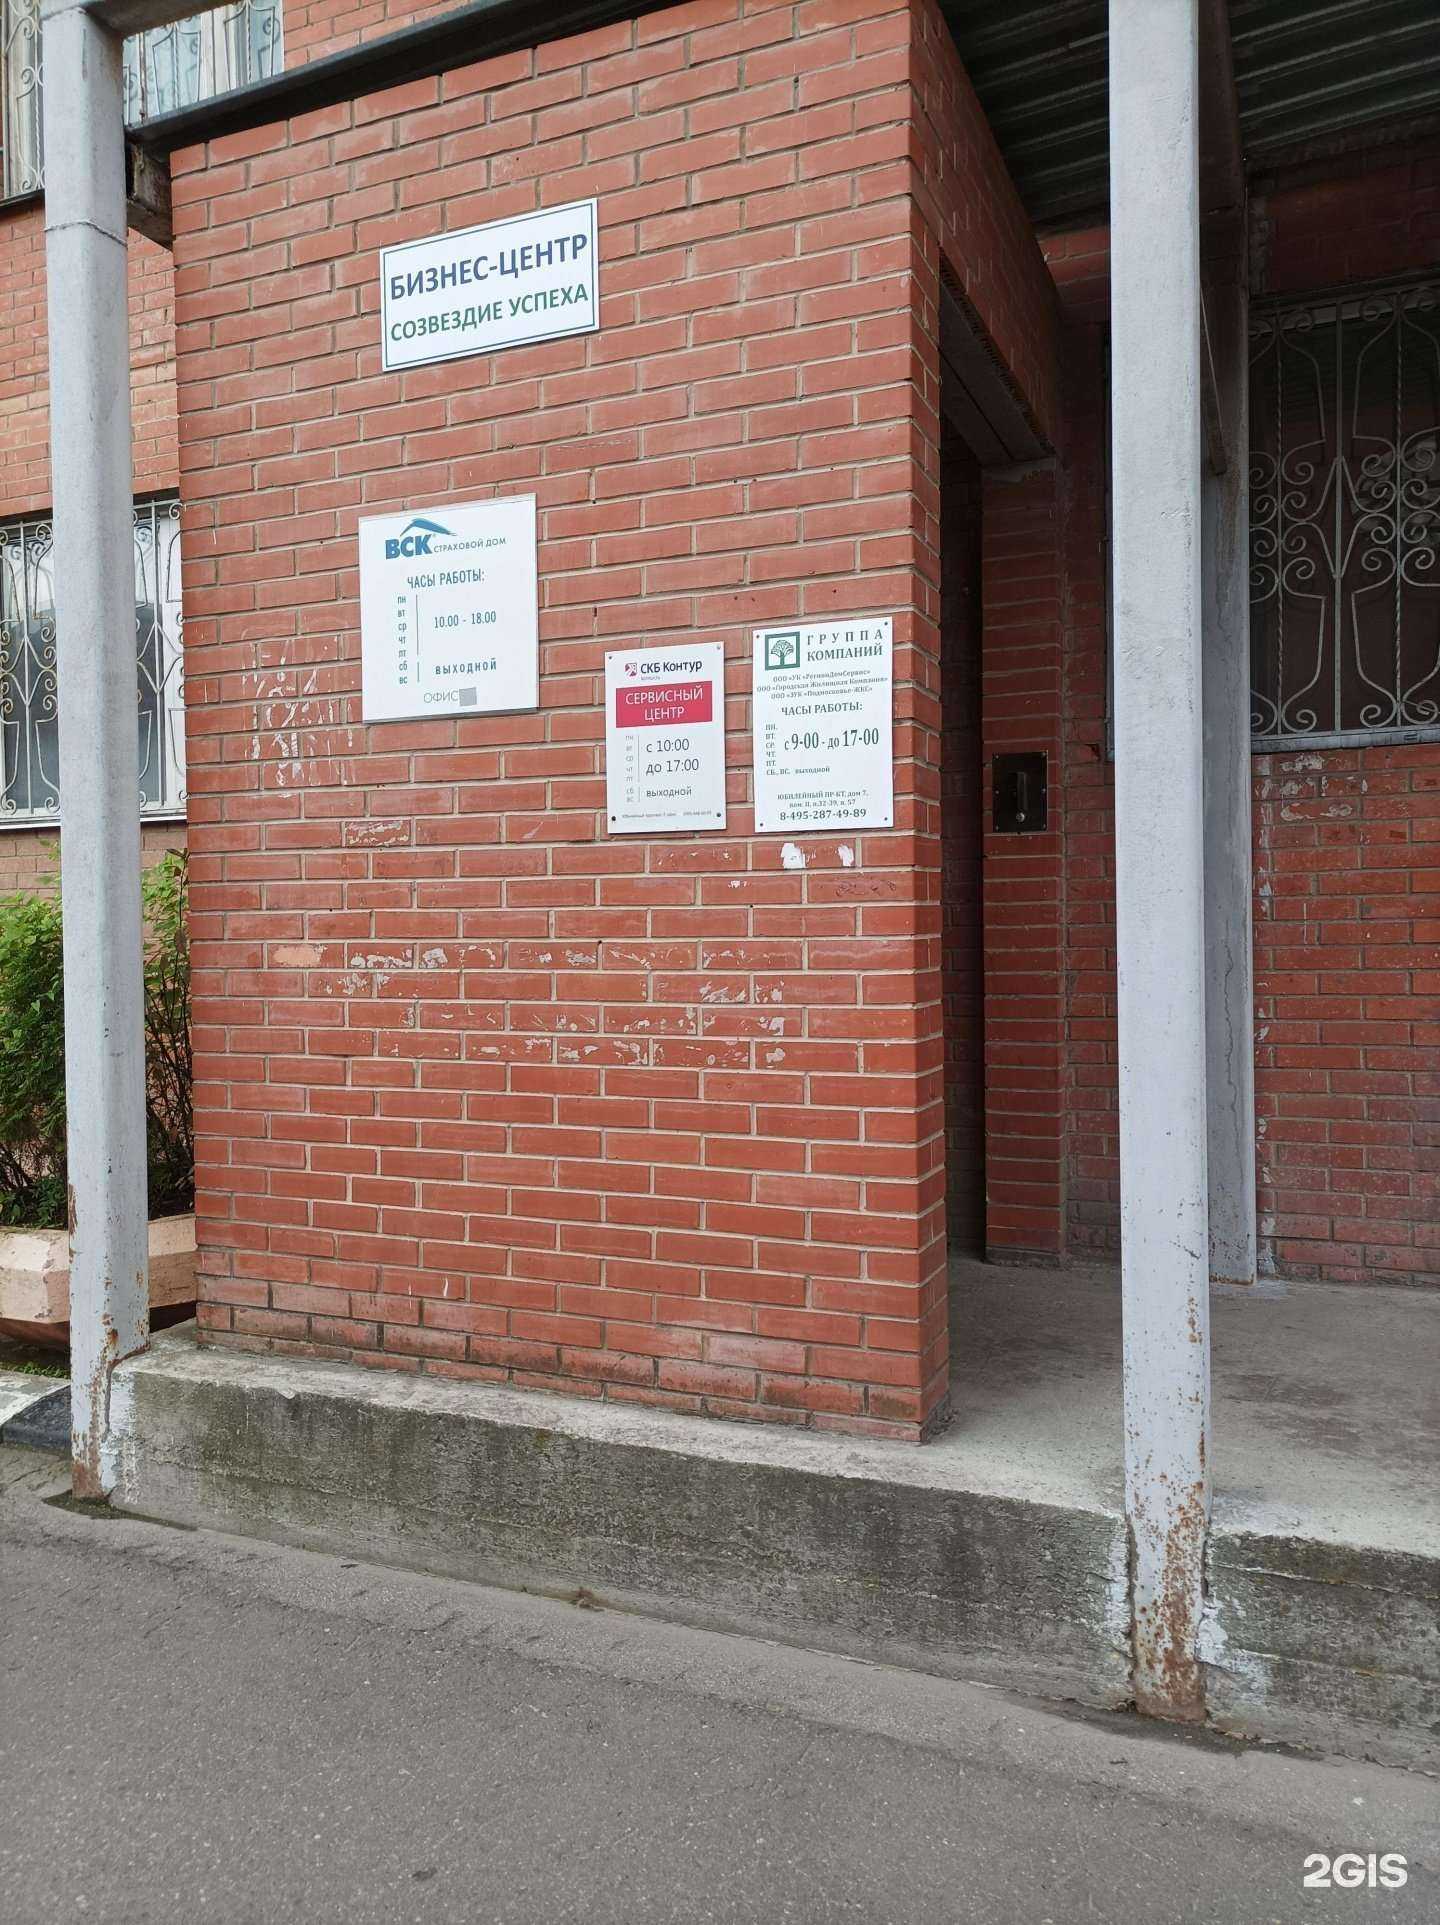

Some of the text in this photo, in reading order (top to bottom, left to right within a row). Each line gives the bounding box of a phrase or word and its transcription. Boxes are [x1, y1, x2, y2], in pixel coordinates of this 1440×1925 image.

[390, 234, 588, 300] БИЗНЕС-ЦЕНТР
[391, 283, 588, 341] СОЗВЕЗДИЕ УСПЕХА
[385, 534, 507, 560] ВСК СТРАХОВОЙ ДОМ
[407, 569, 485, 589] ЧАСЫ РАБОТЫ:
[398, 623, 407, 632] ср
[434, 614, 459, 628] 10.00
[471, 611, 497, 625] 18.00
[807, 629, 883, 645] ГРУППА
[807, 642, 883, 661] КОМПАНИЙ
[399, 660, 408, 671] сб
[435, 657, 497, 675] выходной
[640, 661, 703, 674] СКБ Контур
[424, 690, 459, 703] ОФИС
[625, 685, 703, 705] СЕРВИСНЫЙ
[644, 706, 685, 722] ЦЕНТР
[781, 701, 863, 715] ЧАСЫ РАБОТЫ:
[646, 738, 690, 752] с 10:00
[791, 732, 819, 750] 9-00
[828, 738, 840, 749] до
[842, 728, 879, 747] 17-00
[646, 758, 700, 776] до 17:00
[646, 785, 692, 798] выходной
[779, 808, 867, 821] 8-495-287-49-89
